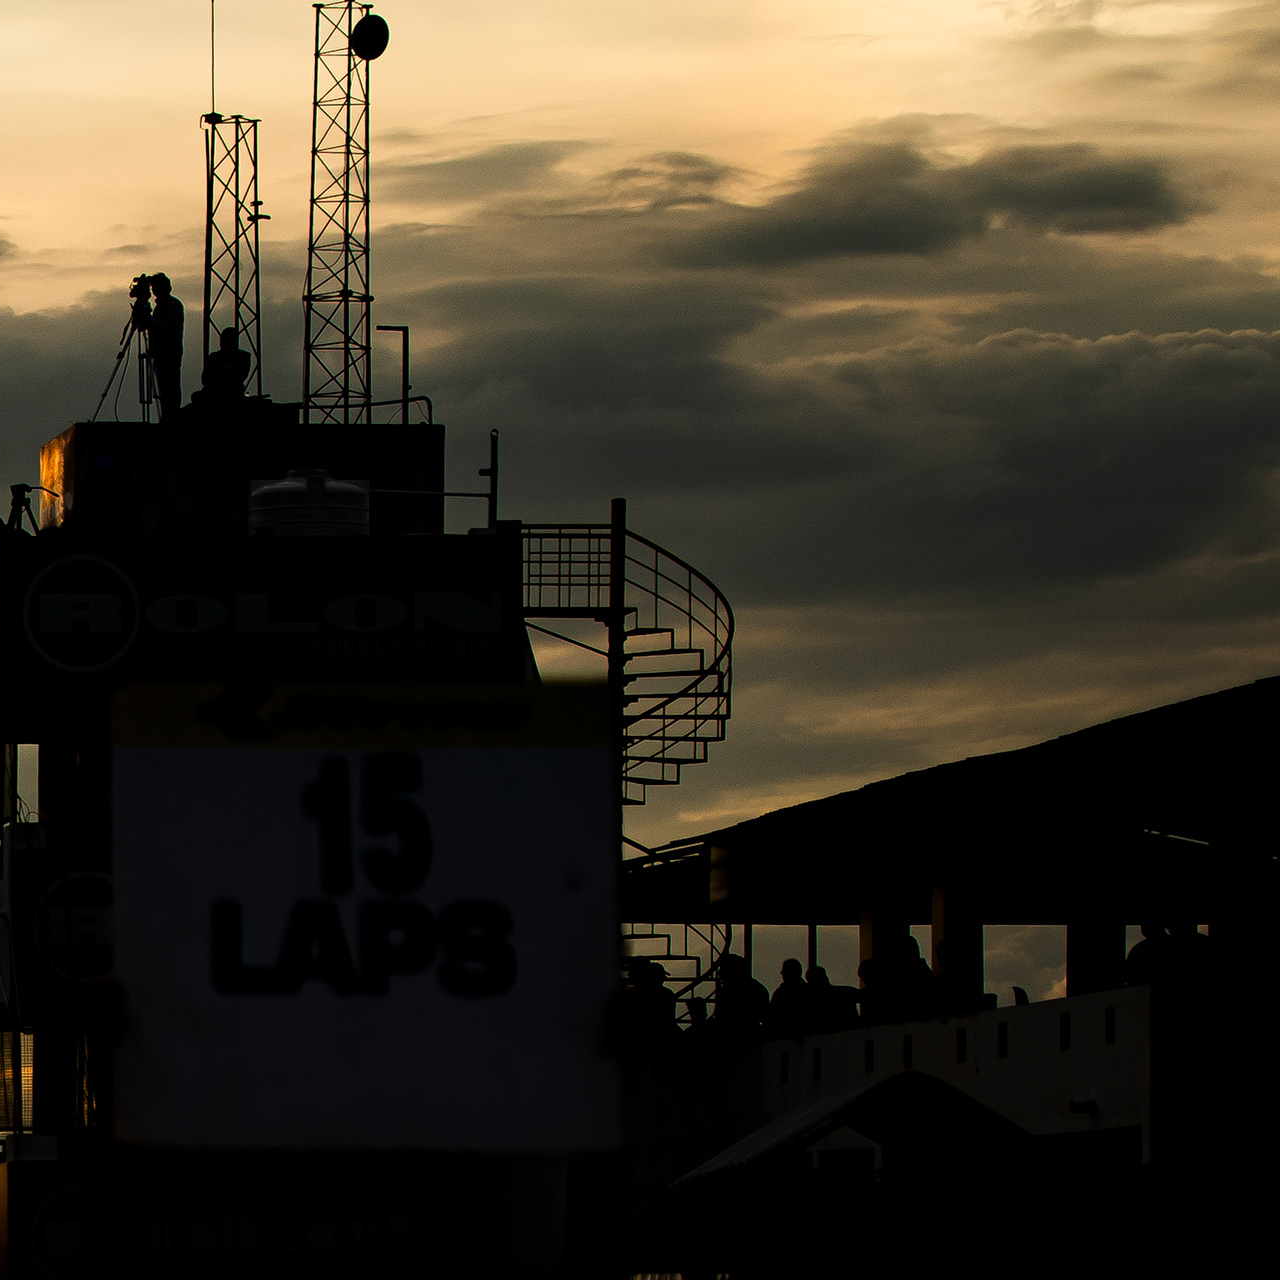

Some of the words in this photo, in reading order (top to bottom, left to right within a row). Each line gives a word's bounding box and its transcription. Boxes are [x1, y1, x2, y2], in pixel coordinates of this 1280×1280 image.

[39, 592, 503, 633] ROLON
[298, 639, 369, 656] CHAINS
[391, 639, 504, 656] SPROCKETS
[303, 752, 434, 896] 15
[213, 899, 517, 996] LAPS
